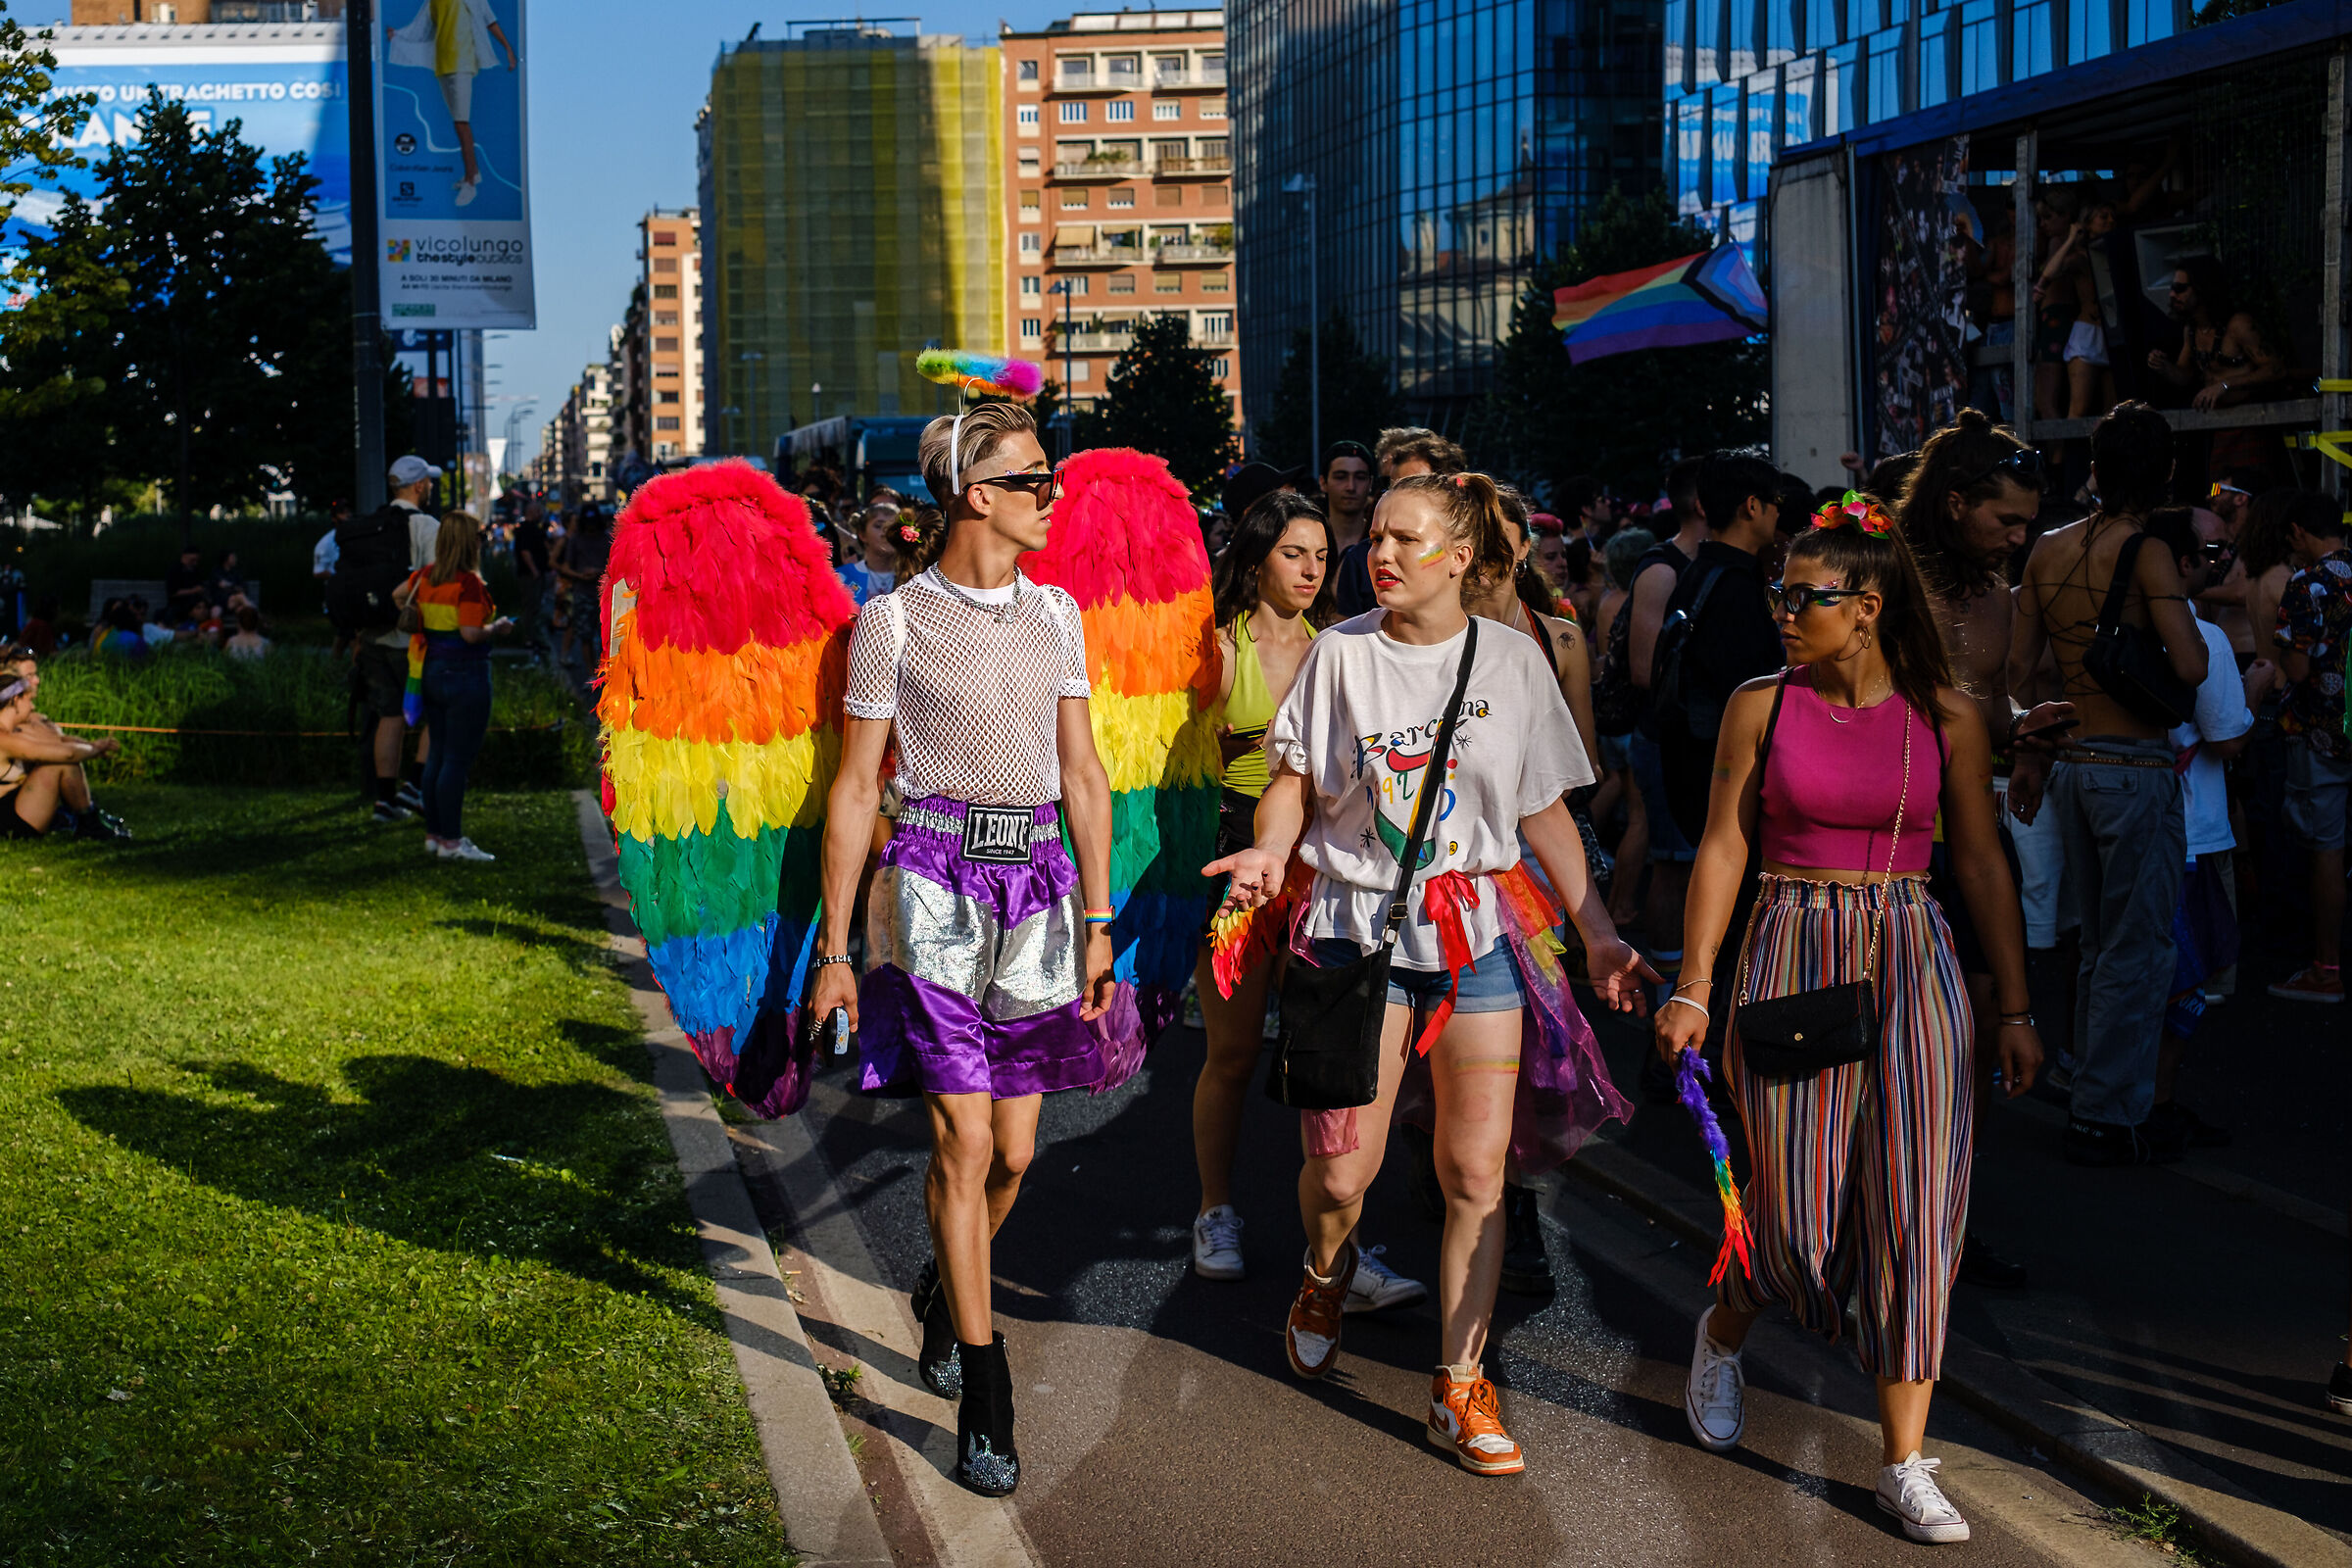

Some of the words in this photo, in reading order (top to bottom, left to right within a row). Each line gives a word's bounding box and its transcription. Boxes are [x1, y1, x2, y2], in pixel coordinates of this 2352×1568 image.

[158, 82, 285, 101] TRAGHETTO
[416, 235, 523, 256] vicolungo
[971, 812, 1030, 854] LEONE
